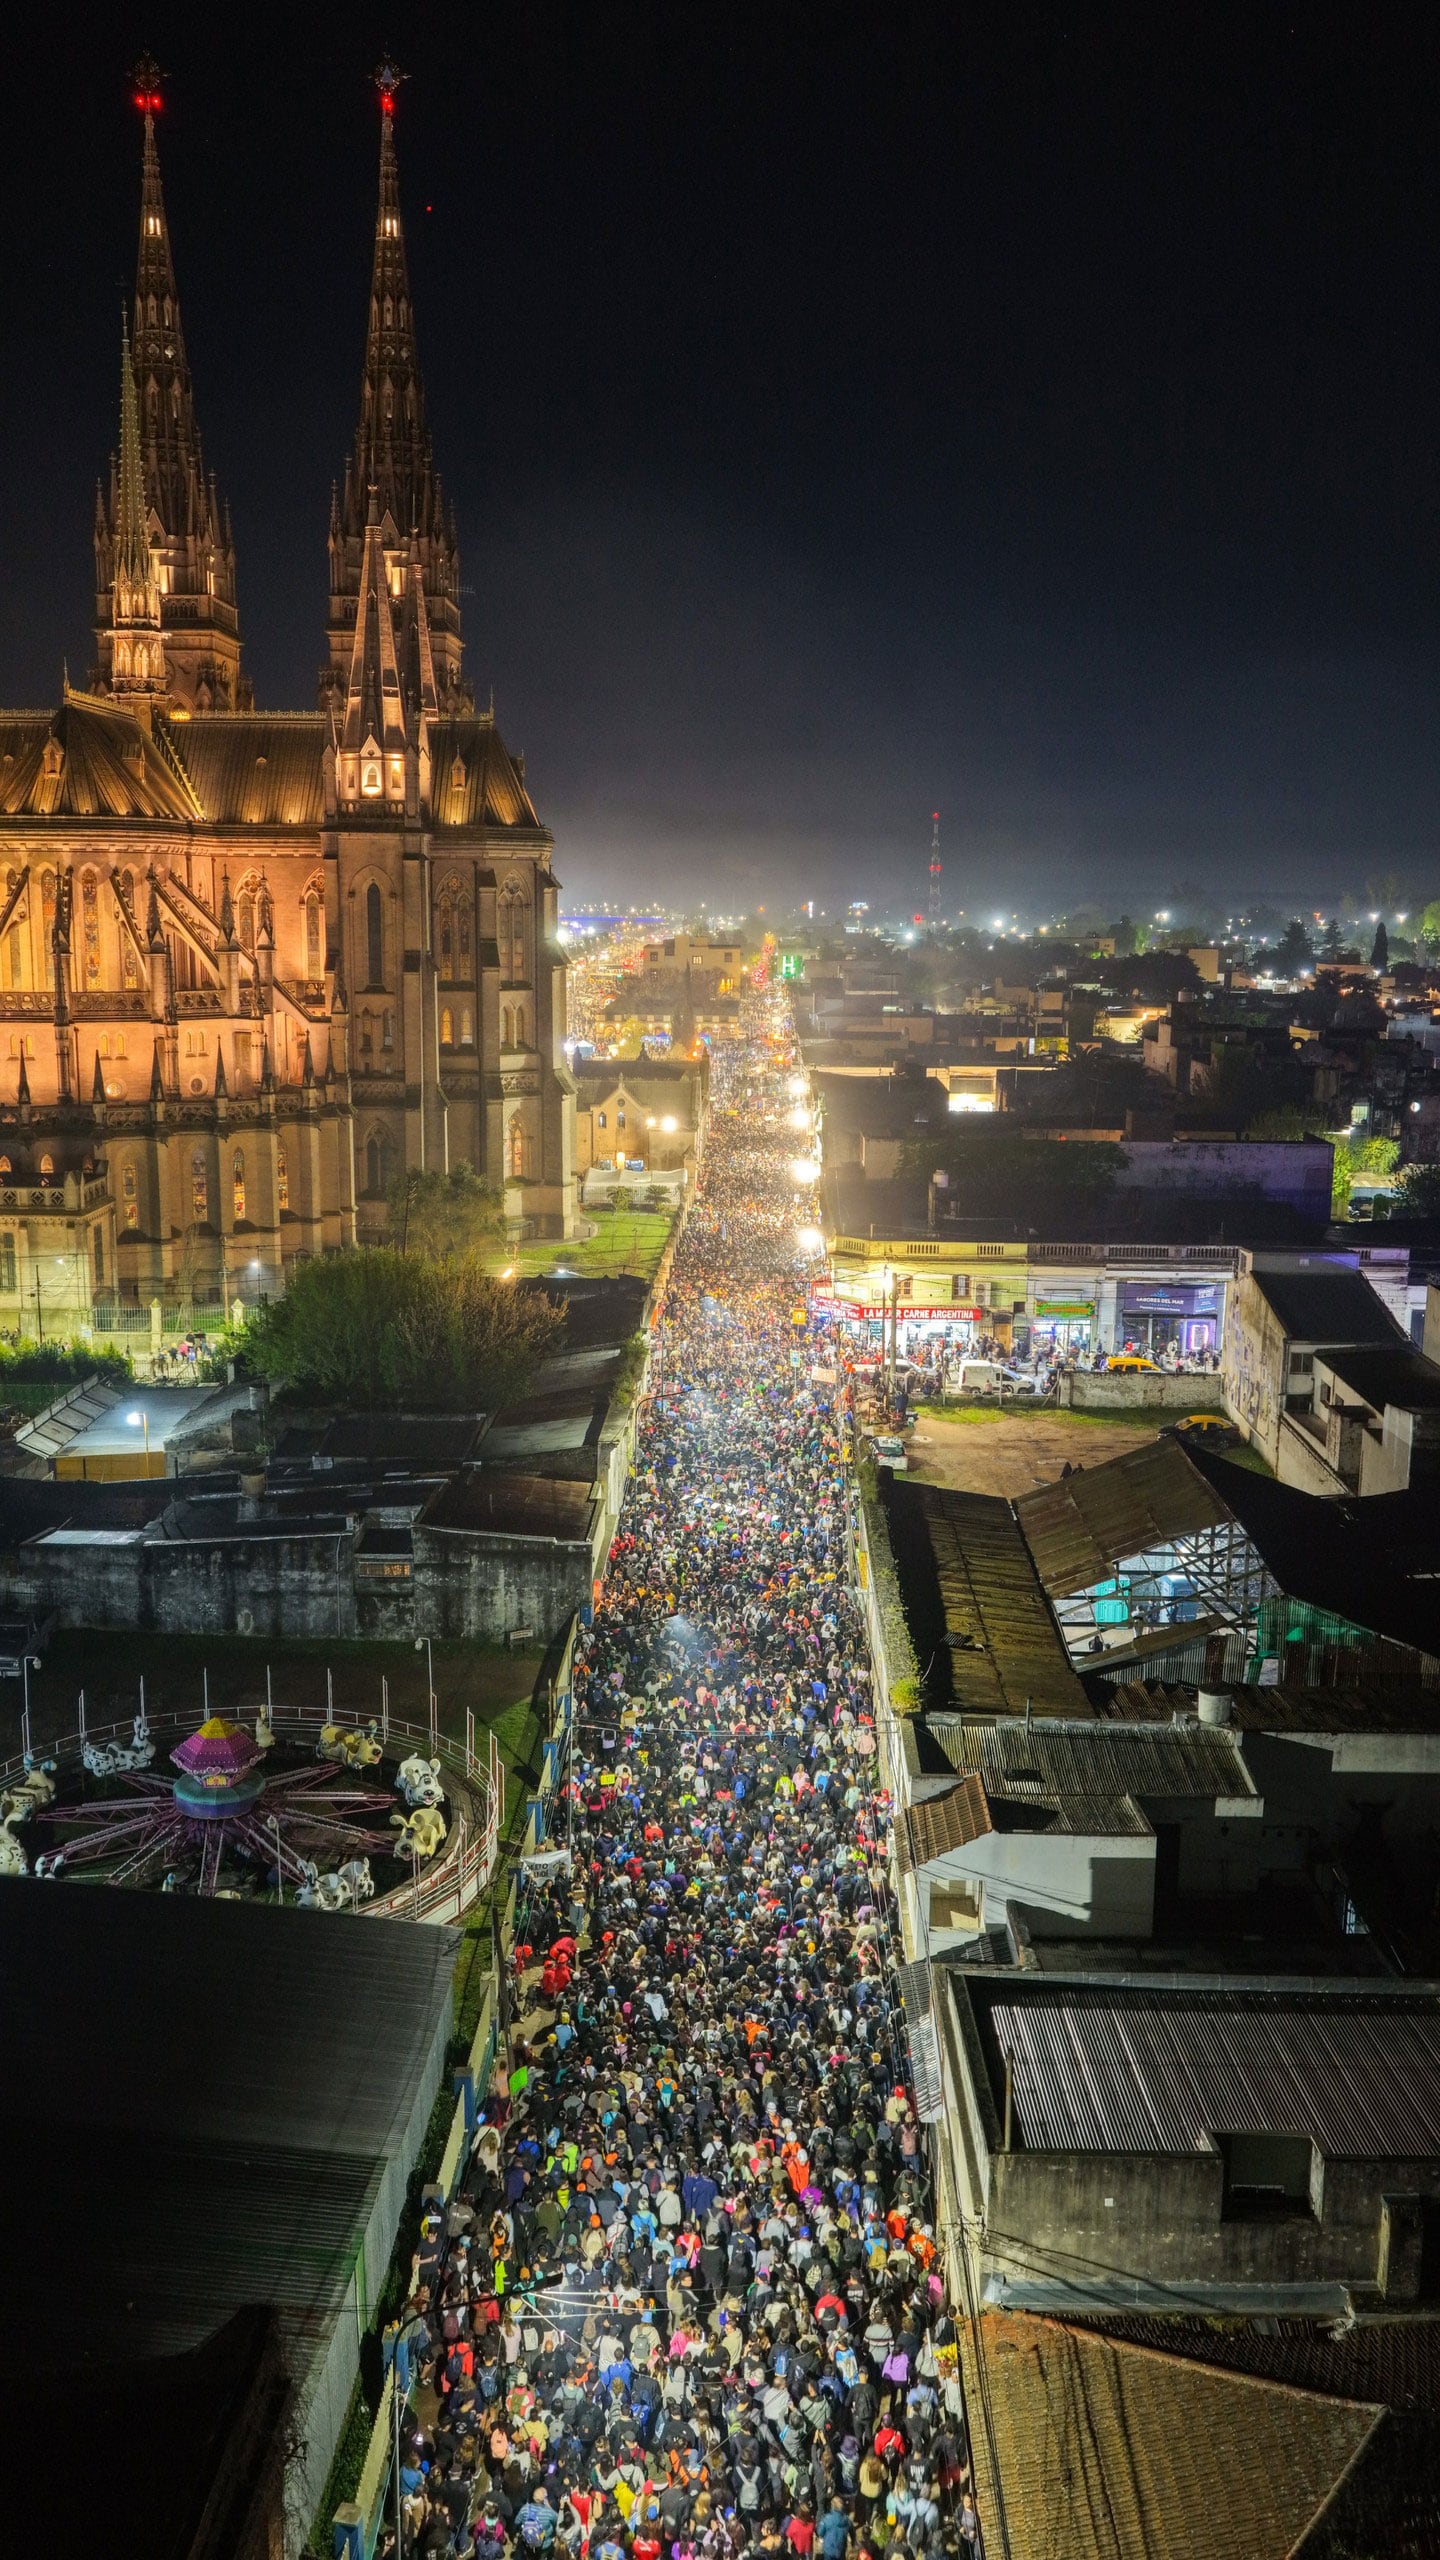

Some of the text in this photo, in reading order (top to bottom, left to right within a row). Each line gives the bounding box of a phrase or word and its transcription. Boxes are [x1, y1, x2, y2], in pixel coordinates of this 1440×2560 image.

[782, 955, 794, 975] H
[863, 1308, 875, 1318] LA
[876, 1308, 902, 1318] MJR
[903, 1309, 930, 1319] CARNE
[931, 1309, 974, 1320] ARGENTINA
